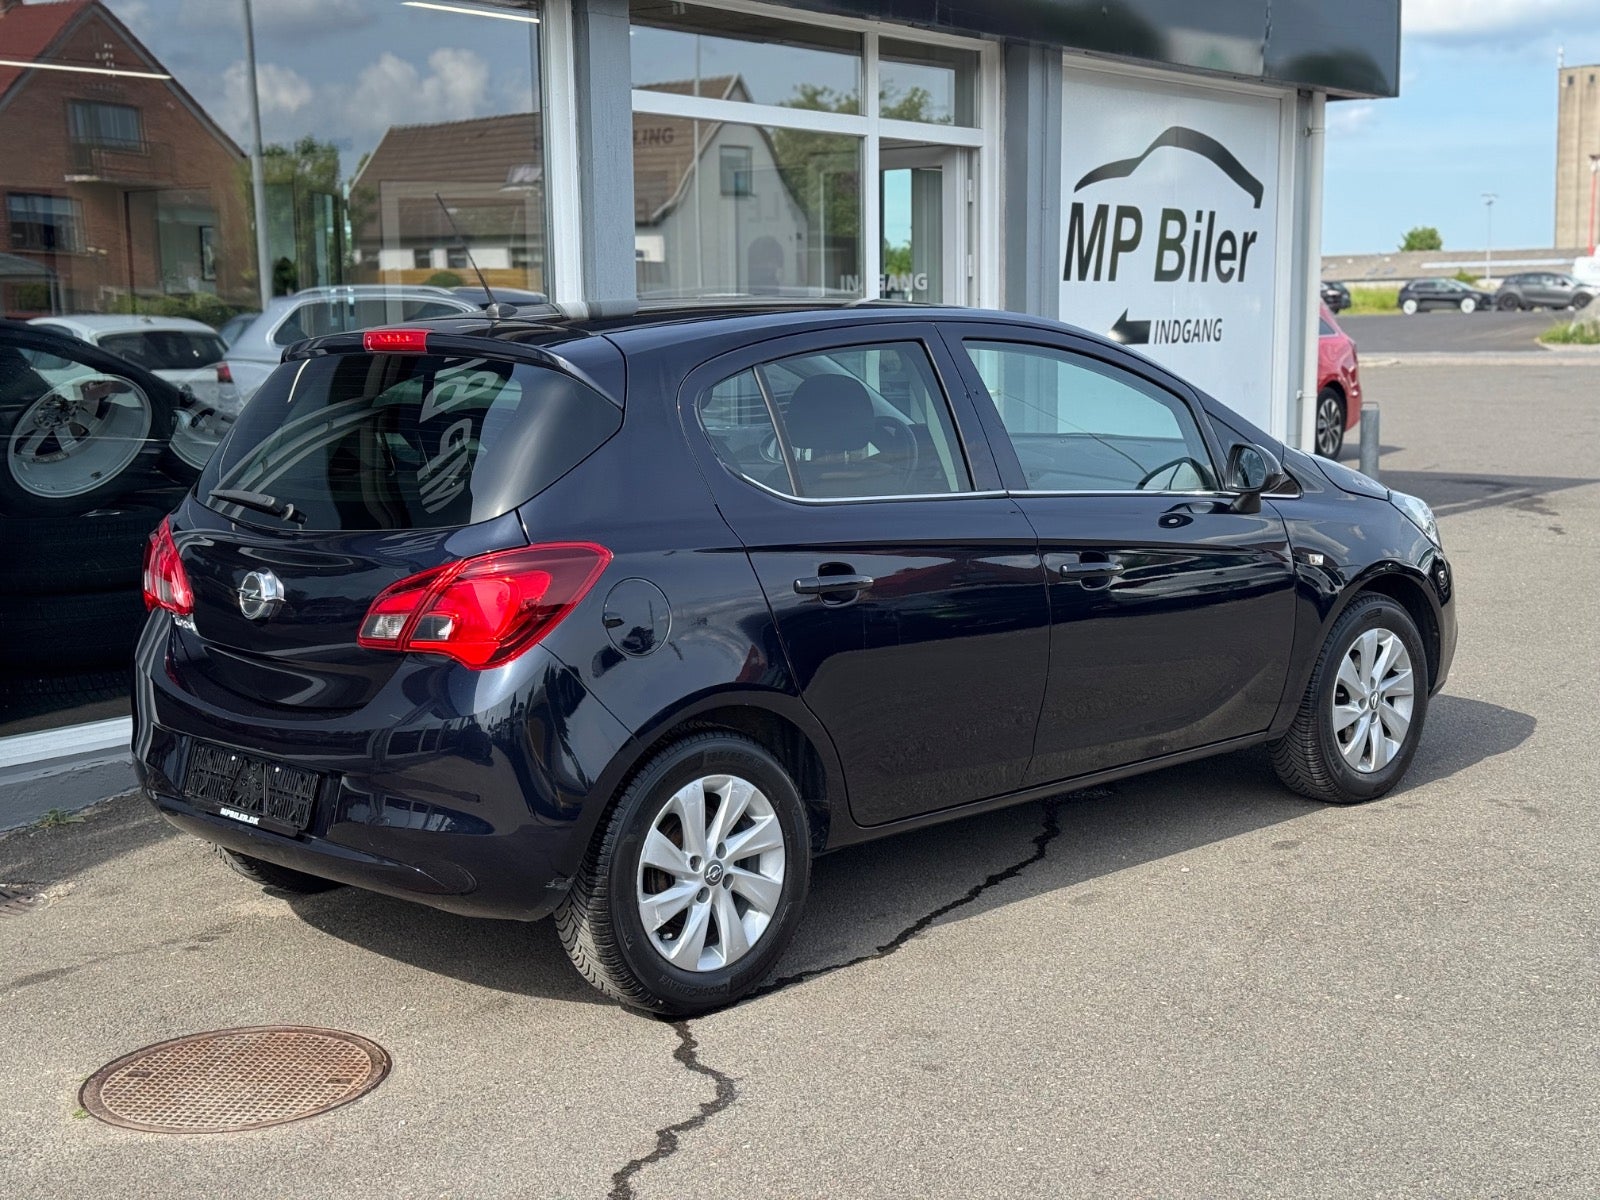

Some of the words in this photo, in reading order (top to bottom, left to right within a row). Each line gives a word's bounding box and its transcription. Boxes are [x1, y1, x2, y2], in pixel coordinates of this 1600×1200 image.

[1063, 202, 1143, 282] MP
[1154, 208, 1257, 283] Biler
[1154, 318, 1223, 344] INDGANG
